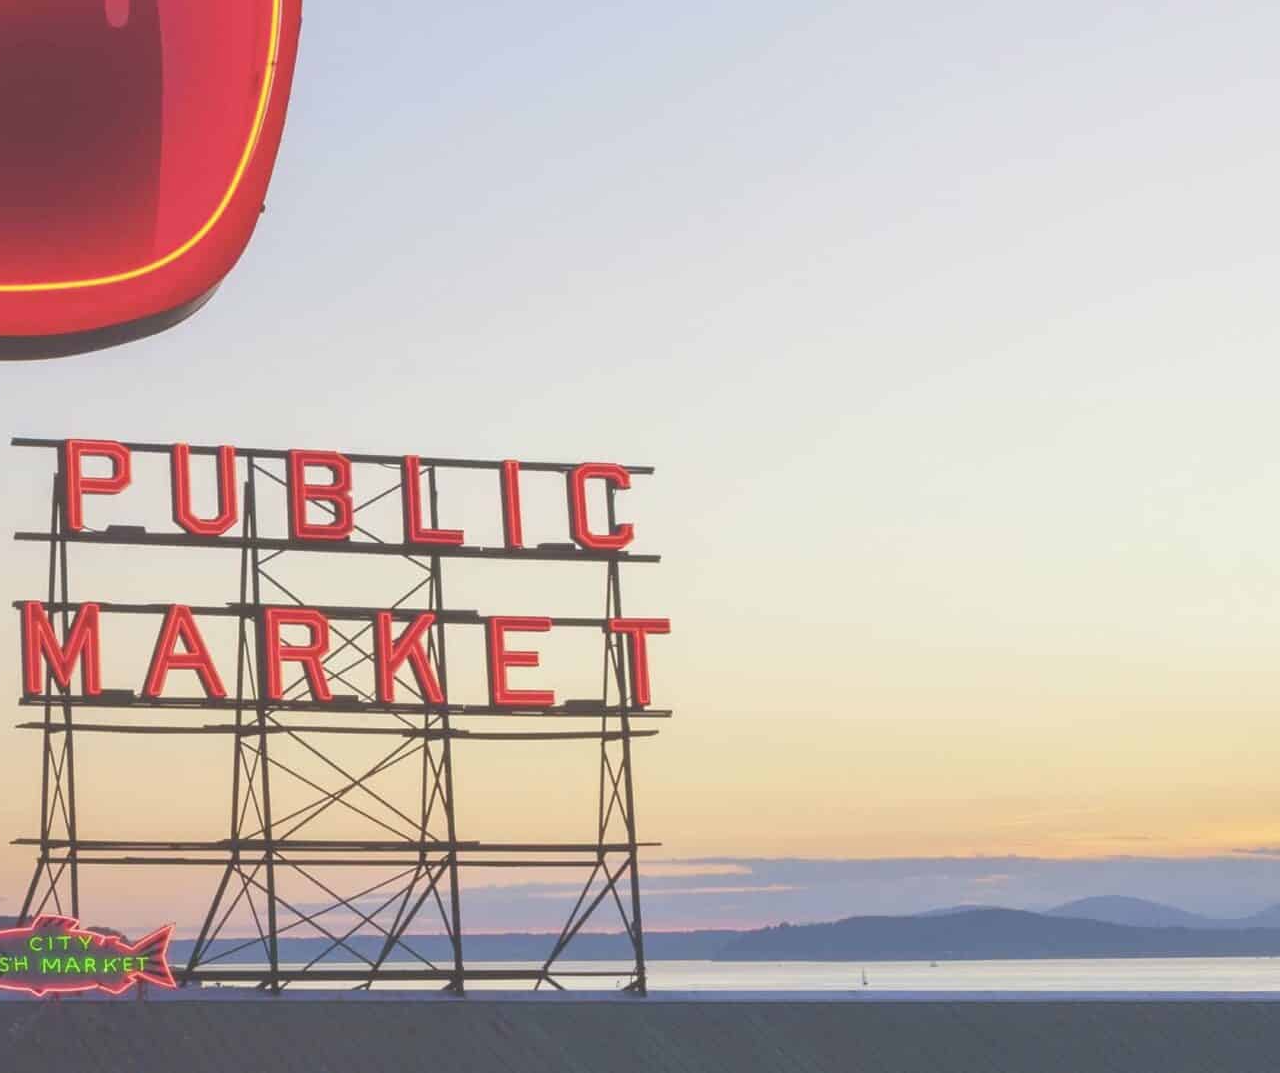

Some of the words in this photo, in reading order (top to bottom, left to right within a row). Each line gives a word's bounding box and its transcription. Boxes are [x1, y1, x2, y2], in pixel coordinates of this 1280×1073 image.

[62, 438, 634, 550] PUBLIC
[22, 600, 671, 707] MARKET
[29, 935, 93, 952] CITY
[41, 956, 150, 974] MARKET
